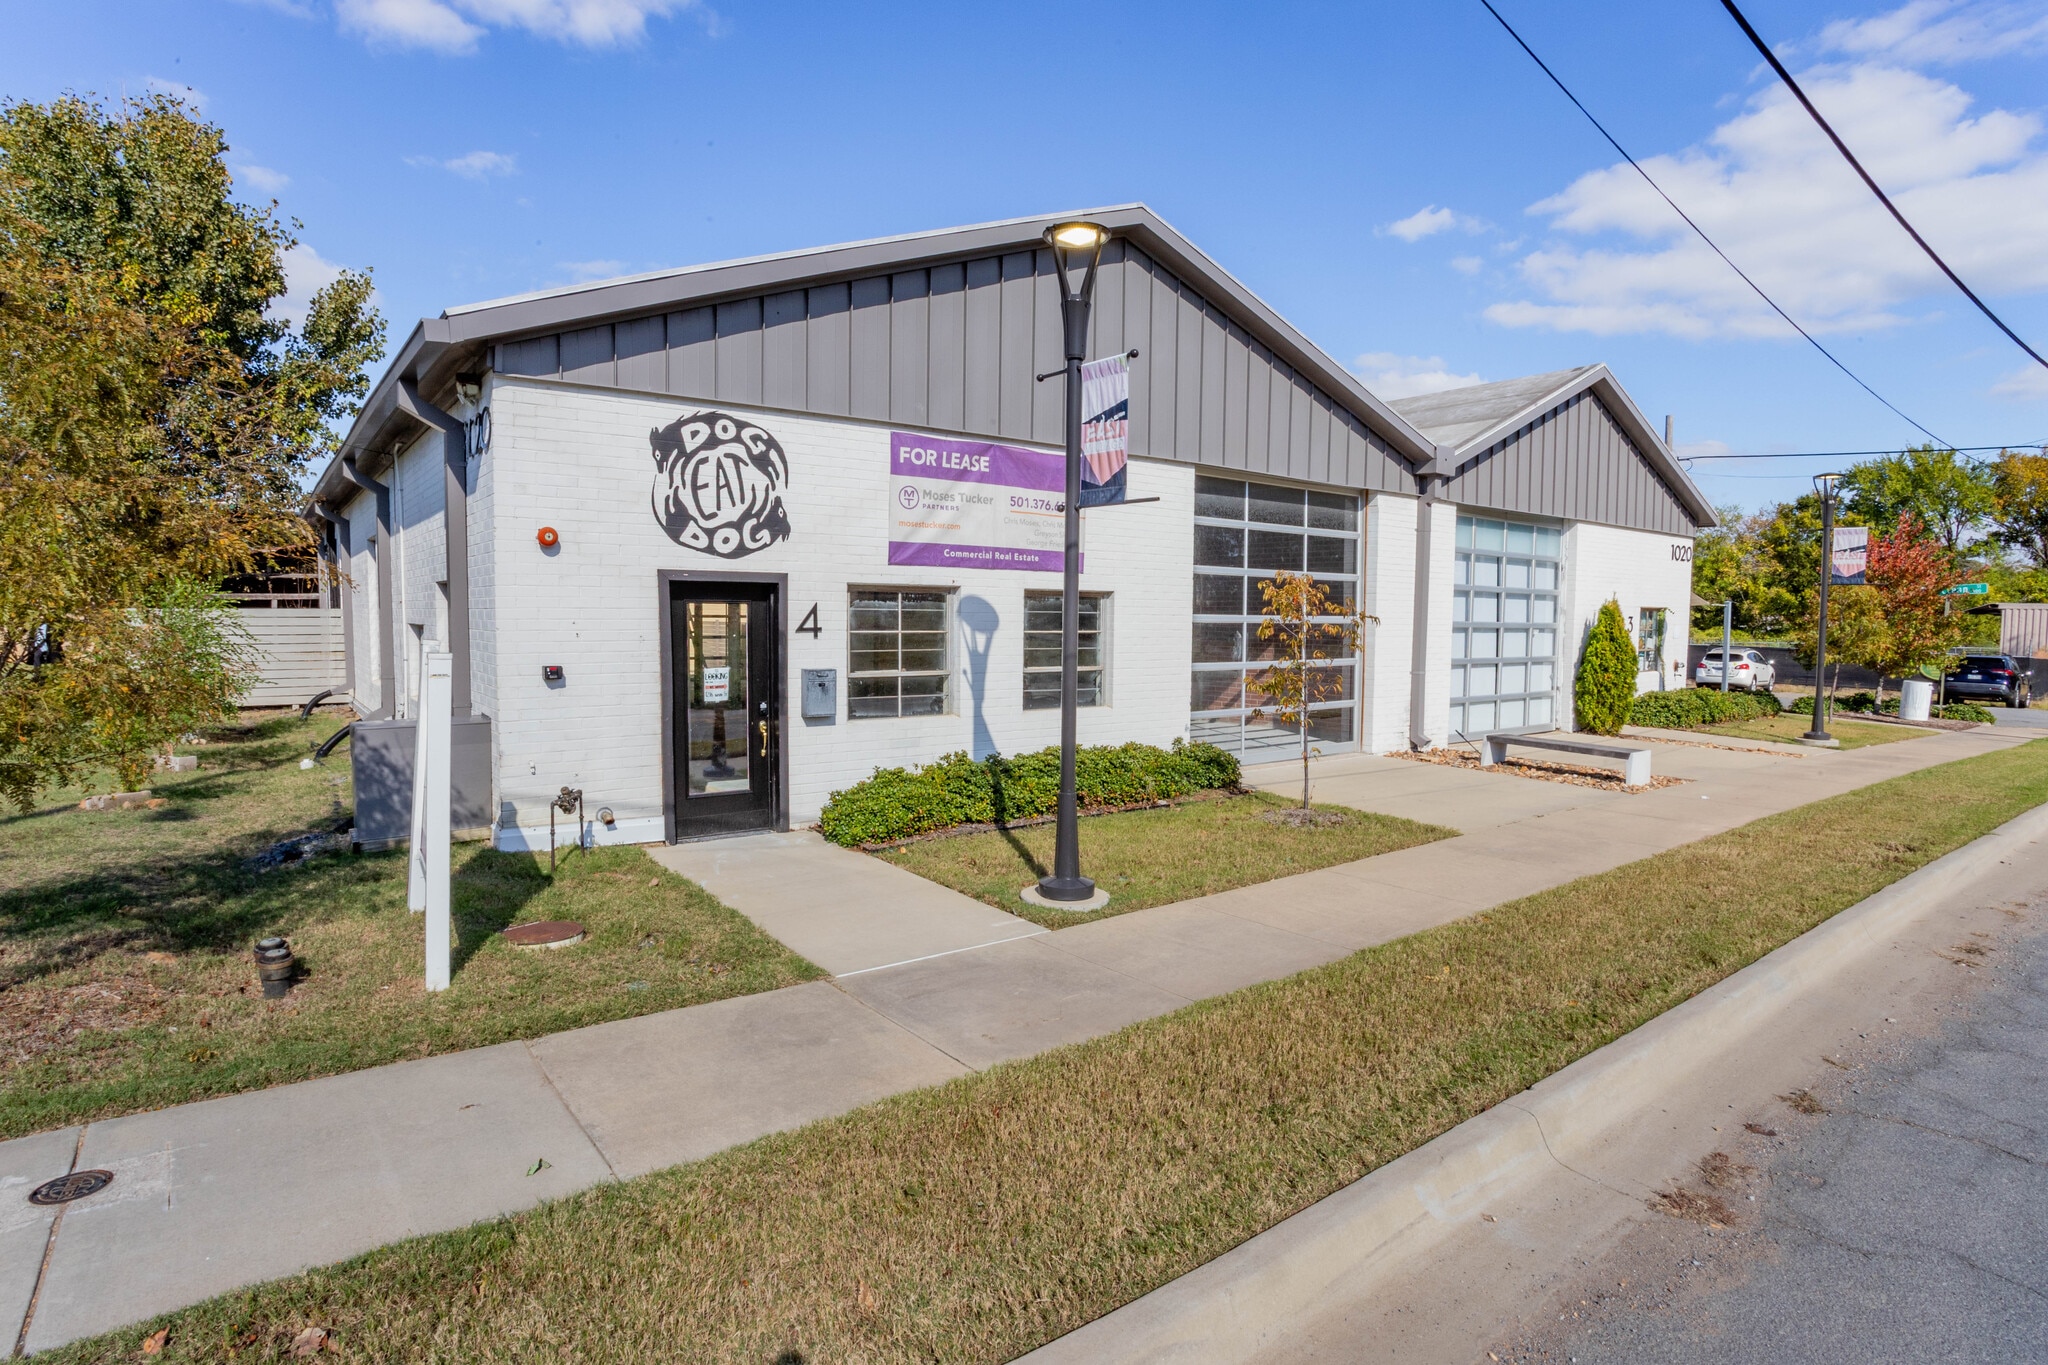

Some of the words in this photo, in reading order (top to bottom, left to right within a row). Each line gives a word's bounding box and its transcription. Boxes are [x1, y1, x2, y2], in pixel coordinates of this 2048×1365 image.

[1086, 411, 1126, 443] EAST
[680, 419, 768, 454] DOG
[899, 446, 937, 467] FOR
[942, 452, 990, 473] LEASE
[691, 452, 749, 522] EAT
[922, 489, 955, 502] Moses
[958, 493, 994, 505] Tucker
[922, 503, 960, 511] PARTNERS
[898, 520, 961, 530] mosestucker.com
[1003, 517, 1018, 525] Chris
[679, 517, 771, 554] DOG
[1034, 529, 1058, 538] Greyson
[1026, 538, 1048, 548] George
[943, 549, 992, 560] Commercial
[995, 551, 1012, 561] Real
[1014, 553, 1039, 562] Estate
[1671, 543, 1692, 564] 1020
[795, 602, 822, 640] 4
[1627, 616, 1634, 633] 3
[704, 672, 728, 680] LOOKING
